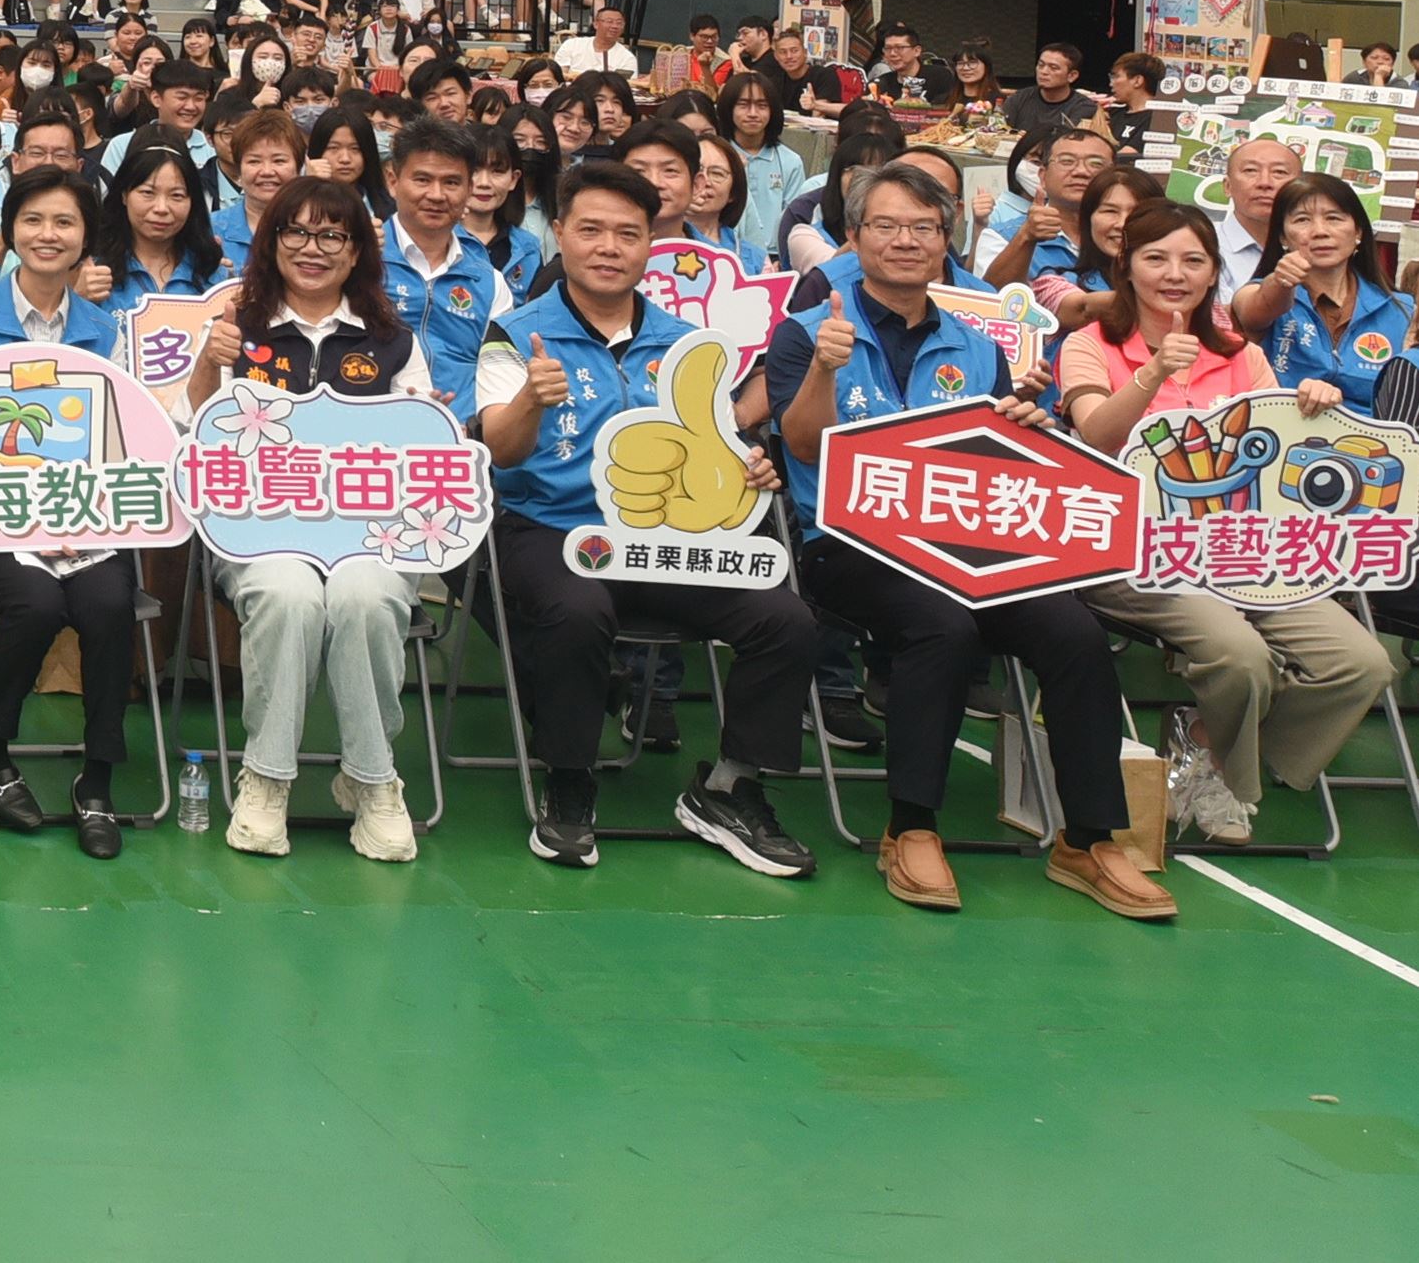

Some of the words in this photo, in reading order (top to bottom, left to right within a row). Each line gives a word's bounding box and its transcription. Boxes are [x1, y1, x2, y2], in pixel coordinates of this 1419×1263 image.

[143, 328, 192, 382] 多
[180, 444, 475, 515] 博覽苗栗
[845, 453, 1123, 553] 原民教育
[624, 542, 776, 577] 苗栗縣政府
[1139, 512, 1417, 580] 技藝教育
